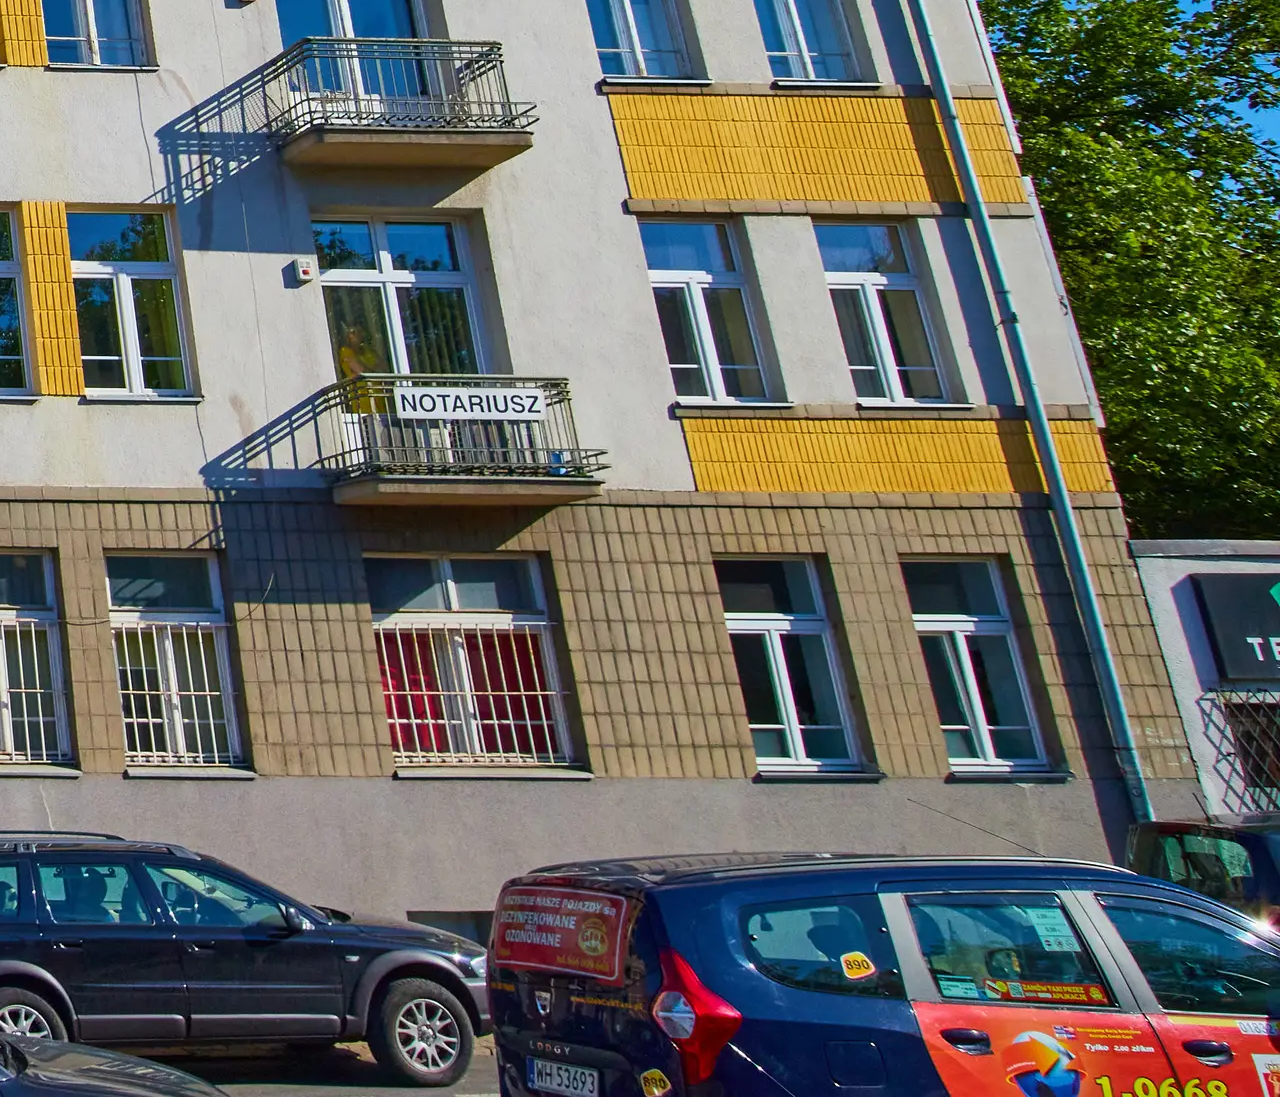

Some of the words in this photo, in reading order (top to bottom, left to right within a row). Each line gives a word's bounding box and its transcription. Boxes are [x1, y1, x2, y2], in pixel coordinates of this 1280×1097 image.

[400, 393, 541, 414] NOTARIUSZ
[535, 897, 561, 908] NASZE
[561, 898, 603, 914] POJAZDY
[505, 930, 562, 948] OZONOWANE
[844, 959, 870, 970] 890
[529, 1040, 571, 1055] LODGY
[1084, 1043, 1109, 1052] Tylko
[535, 1061, 553, 1085] WH
[556, 1065, 595, 1094] 53693
[643, 1075, 667, 1090] 890
